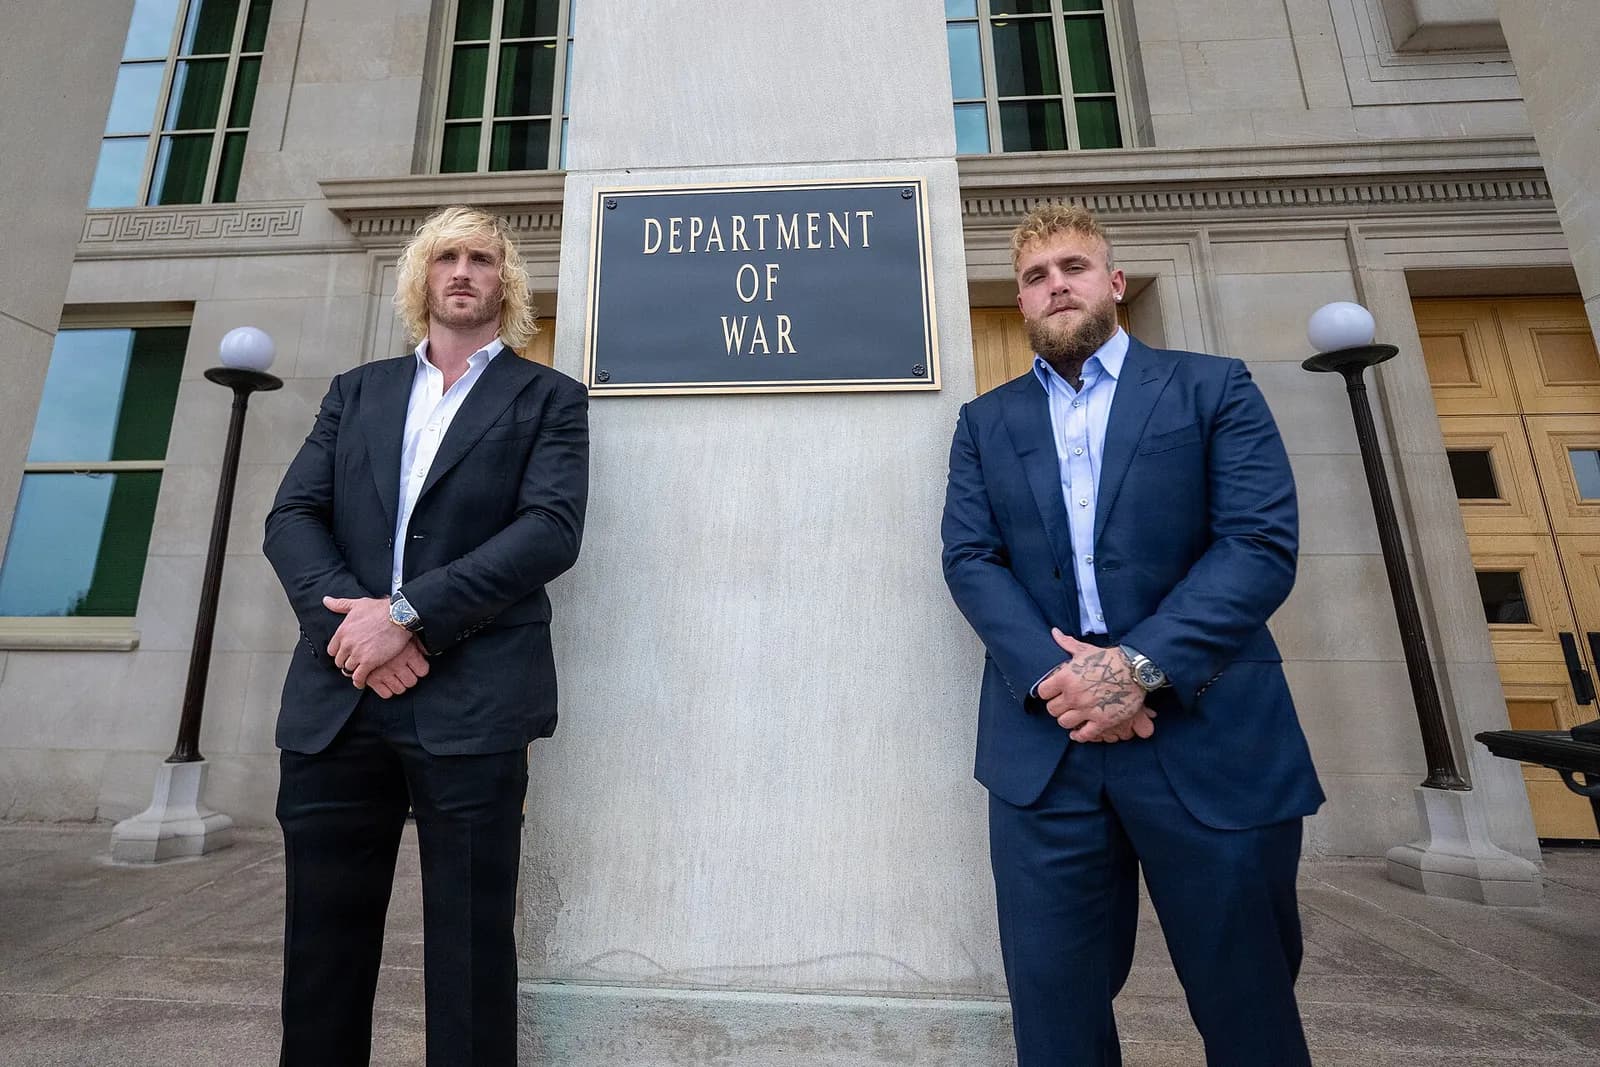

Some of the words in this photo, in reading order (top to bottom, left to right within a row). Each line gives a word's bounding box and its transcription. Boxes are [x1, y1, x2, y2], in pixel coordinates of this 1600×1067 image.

[642, 210, 875, 254] DEPARTMENT
[735, 263, 781, 303] OF
[720, 314, 798, 356] WAR
